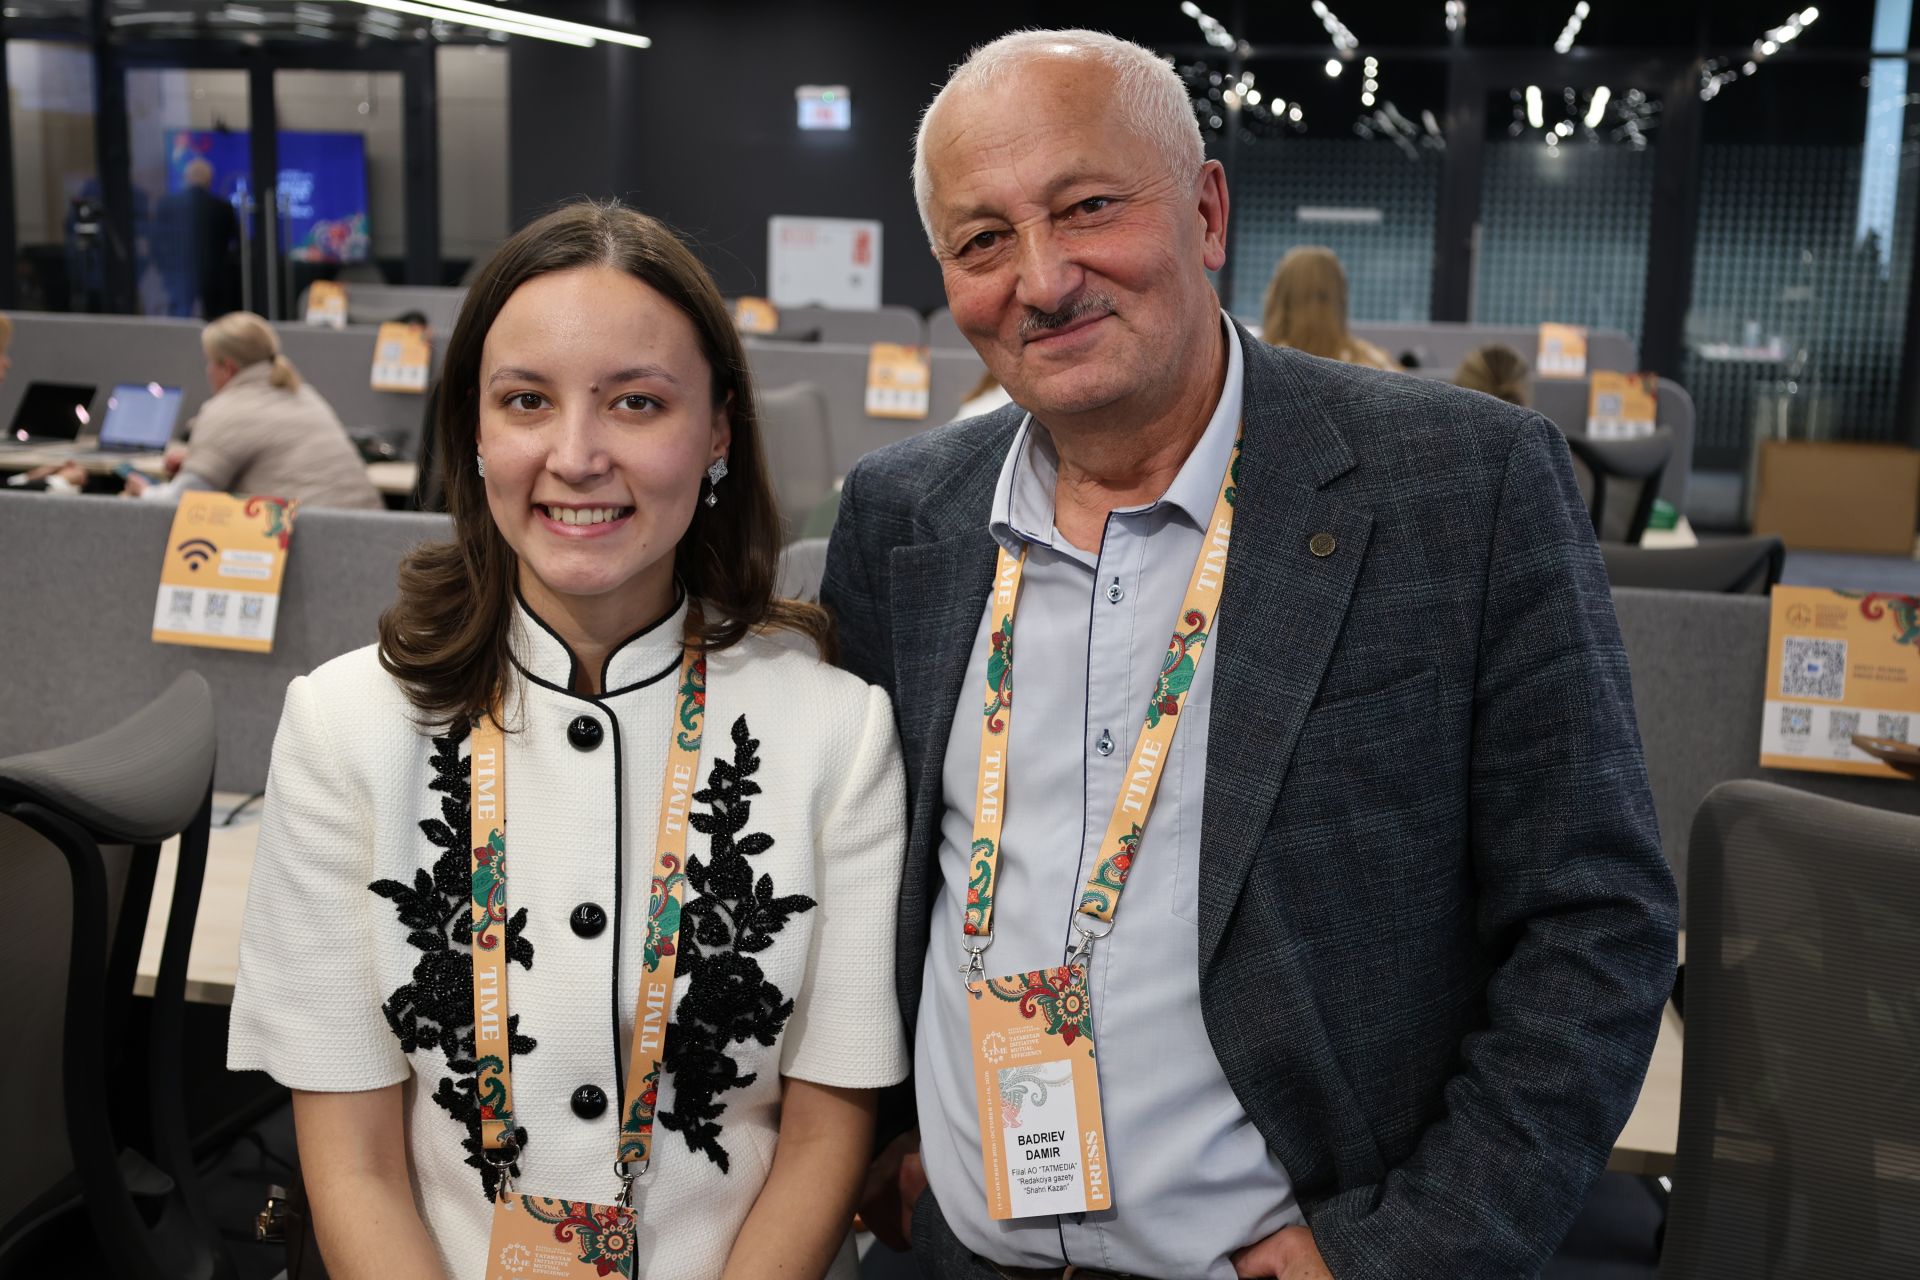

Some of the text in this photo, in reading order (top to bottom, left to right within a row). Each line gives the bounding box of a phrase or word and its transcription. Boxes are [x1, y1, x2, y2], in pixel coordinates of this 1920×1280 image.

[1196, 519, 1232, 591] TIME
[477, 747, 496, 820] TIME
[665, 764, 691, 836] TIME
[980, 750, 1002, 824] TIME
[1121, 739, 1162, 813] TIME
[479, 966, 500, 1041] TIME
[639, 982, 667, 1054] TIME
[1012, 1162, 1078, 1176] Filial AO "TATMEDIA"
[1017, 1130, 1065, 1146] BADRIEV
[1026, 1147, 1061, 1161] DAMIR
[1085, 1130, 1104, 1200] PRESS
[1047, 1183, 1070, 1193] Kazan"
[1054, 1174, 1074, 1184] gazety
